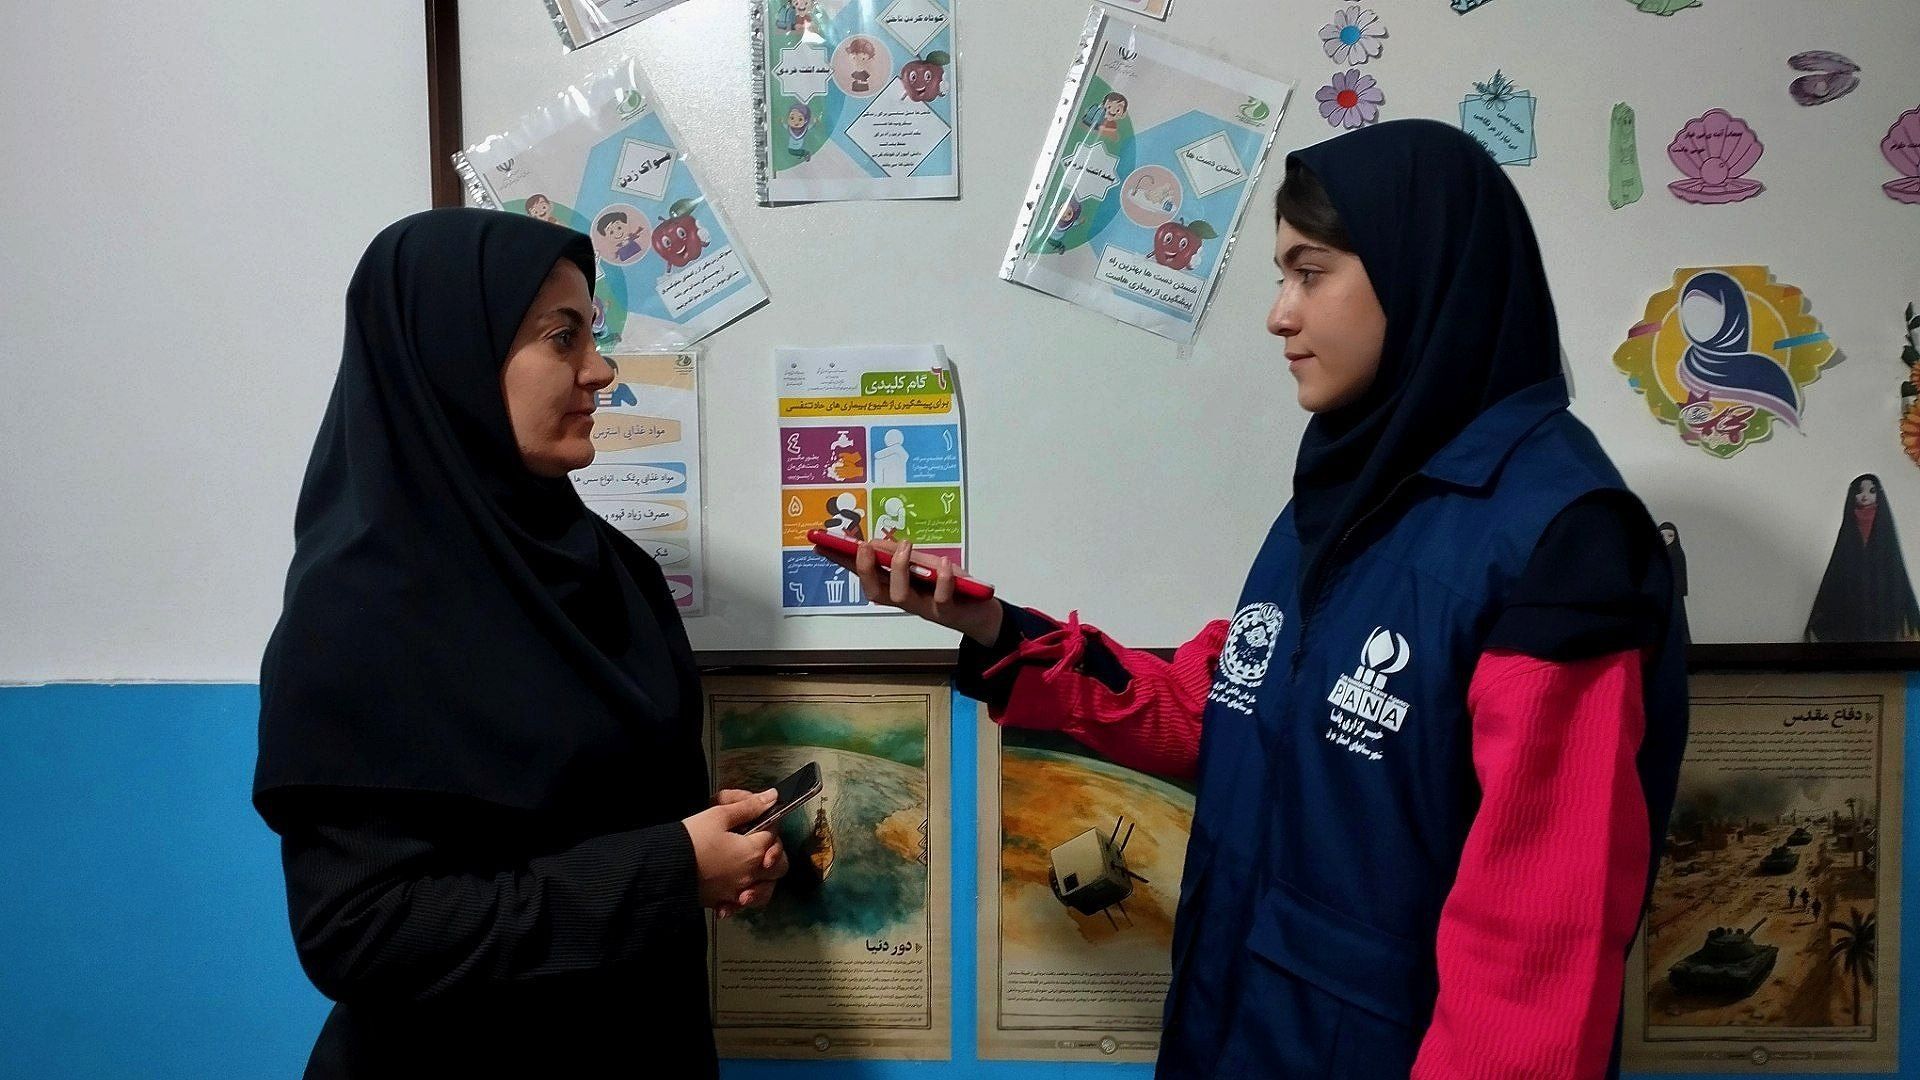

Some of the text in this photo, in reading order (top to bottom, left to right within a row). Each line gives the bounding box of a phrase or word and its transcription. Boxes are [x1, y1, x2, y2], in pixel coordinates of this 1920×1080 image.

[904, 14, 923, 23] کردن
[924, 14, 945, 23] کوتاه
[777, 68, 797, 76] فردی
[1186, 150, 1241, 176] شستن دست ها
[620, 152, 671, 188] مسواک زدن
[1086, 167, 1116, 182] بهداشت
[1109, 257, 1197, 294] شستن دست ها بهترین راه
[1105, 272, 1192, 311] پیشگیری از بیماری هاست
[865, 376, 906, 395] کلیدی
[907, 374, 929, 394] گام
[786, 402, 814, 412] تنفسی
[826, 403, 840, 411] های
[845, 401, 867, 412] بیماری
[868, 401, 889, 411] شیوع
[888, 400, 895, 409] از
[894, 399, 933, 411] پیشگیری
[935, 398, 949, 409] برای
[593, 426, 621, 439] استرس
[649, 425, 666, 439] مواد
[943, 429, 953, 451] ۱
[573, 475, 581, 483] ها
[583, 478, 599, 486] سس
[599, 475, 614, 486] انواع
[660, 474, 674, 484] مواد
[787, 495, 804, 517] ۵
[941, 492, 955, 514] ۲
[610, 508, 625, 521] قهوه
[627, 510, 642, 521] زیاد
[643, 509, 670, 522] مصرف
[653, 547, 669, 560] شکر
[1330, 681, 1404, 729] PANA
[1330, 708, 1344, 728] پانا
[1783, 708, 1863, 729] دفاع مقدس
[866, 939, 913, 956] دور دنیا
